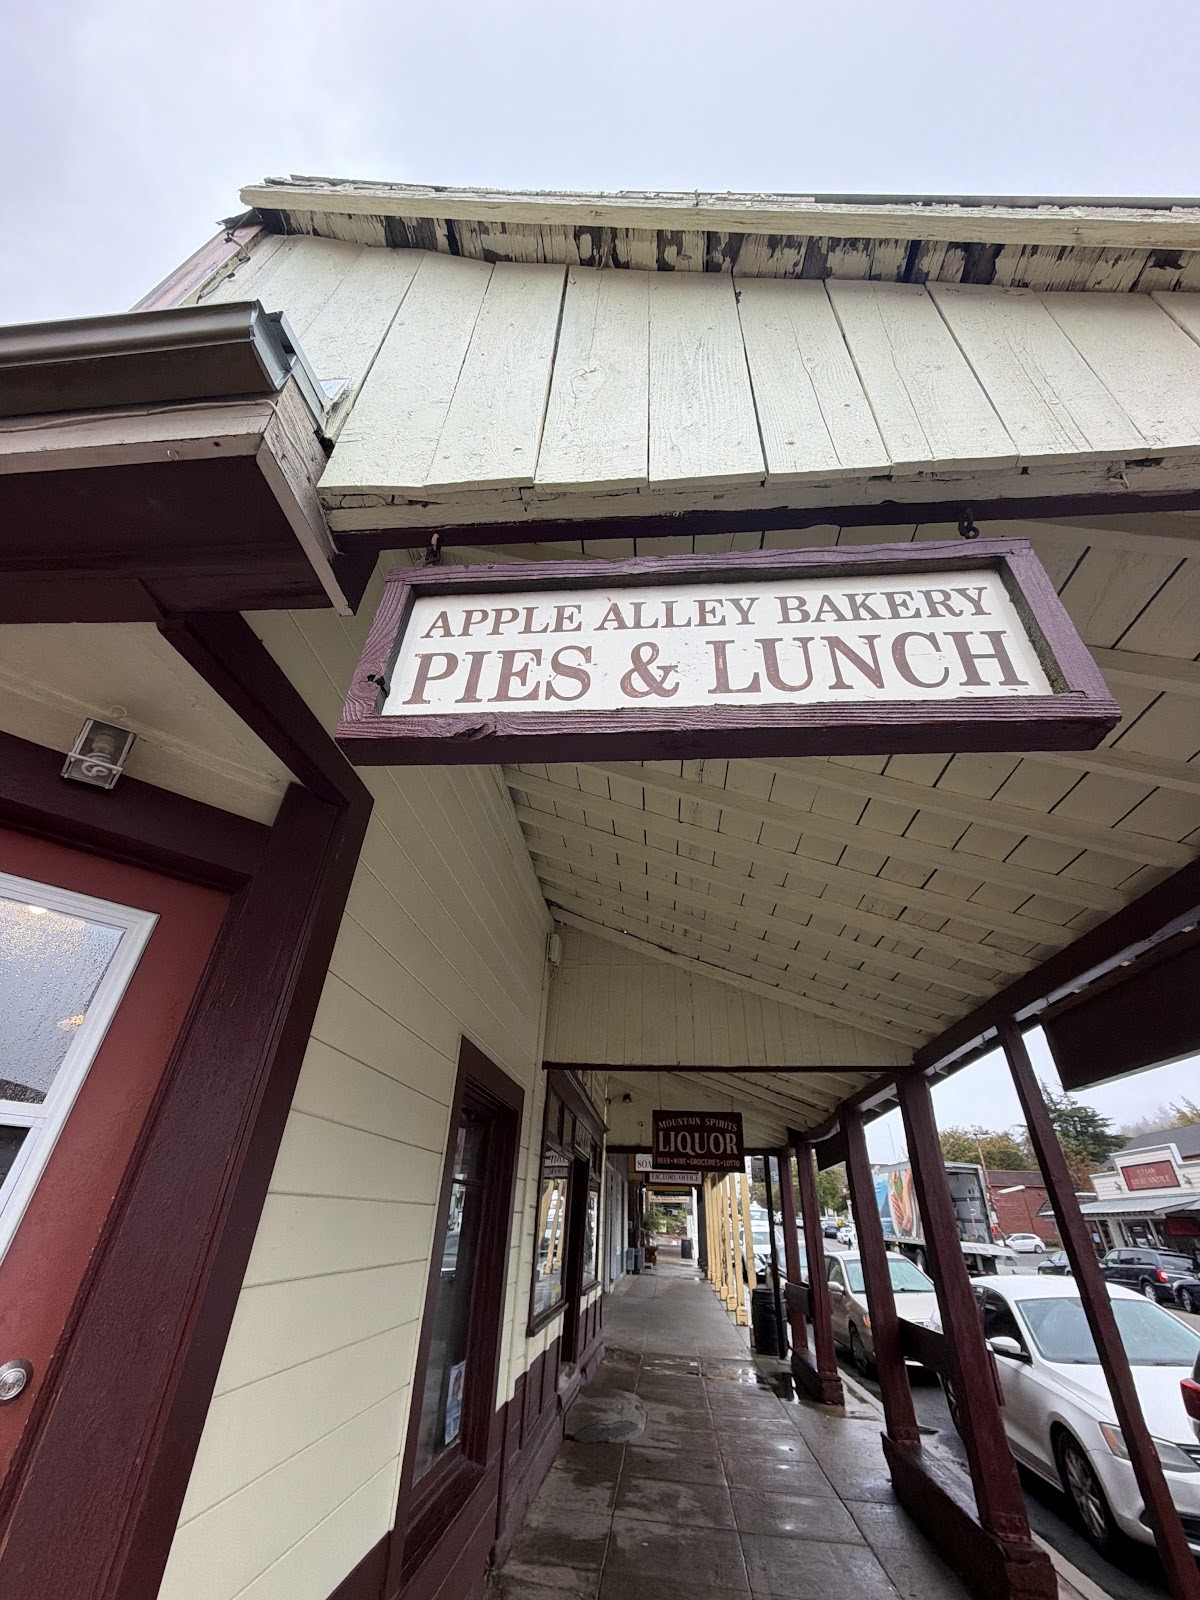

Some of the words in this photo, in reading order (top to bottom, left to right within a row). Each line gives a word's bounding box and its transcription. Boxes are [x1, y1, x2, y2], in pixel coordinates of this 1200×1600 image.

[420, 604, 583, 639] APPLE
[593, 597, 760, 634] ALLEY
[774, 586, 993, 625] BAKERY
[401, 645, 593, 706] PIES
[619, 641, 681, 699] &
[705, 630, 1030, 695] LUNCH
[658, 1117, 700, 1128] MOUNTAIN
[704, 1118, 738, 1131] SPIRITS
[658, 1131, 739, 1155] LIQUOR
